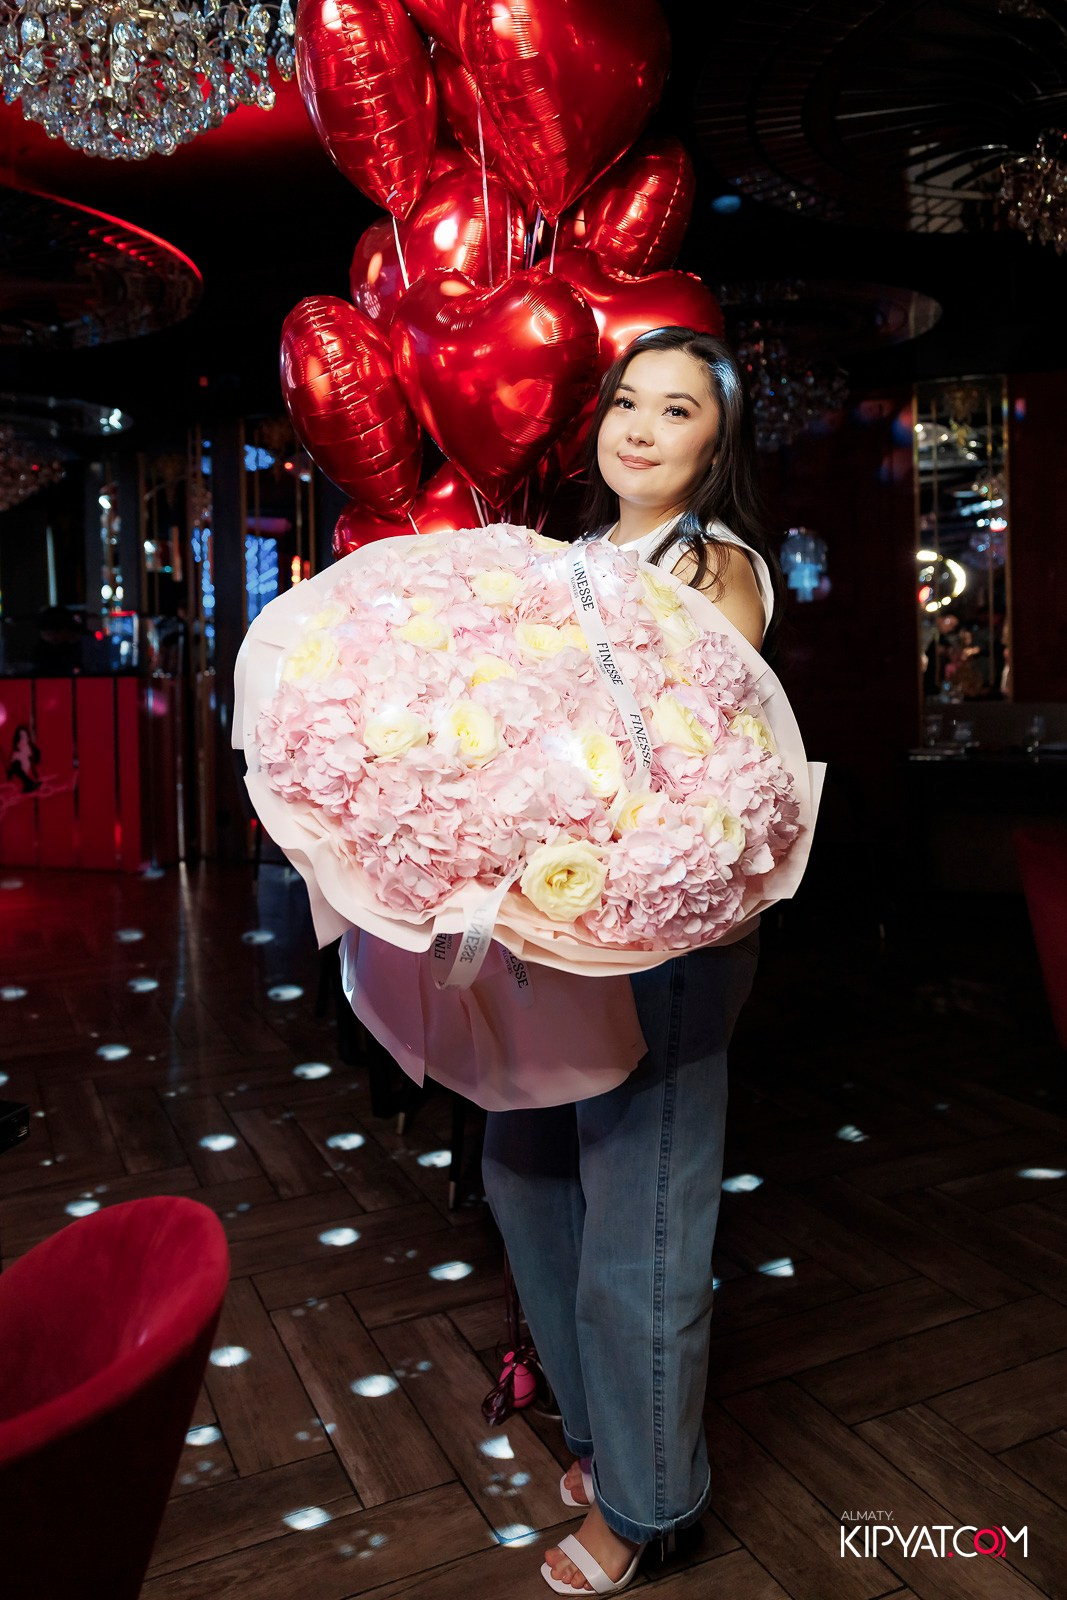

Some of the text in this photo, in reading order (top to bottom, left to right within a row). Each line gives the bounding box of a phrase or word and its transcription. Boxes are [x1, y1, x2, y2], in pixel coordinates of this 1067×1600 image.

[573, 560, 595, 611] FINESSE
[596, 642, 624, 686] FINESSE
[629, 713, 651, 769] FINESSE
